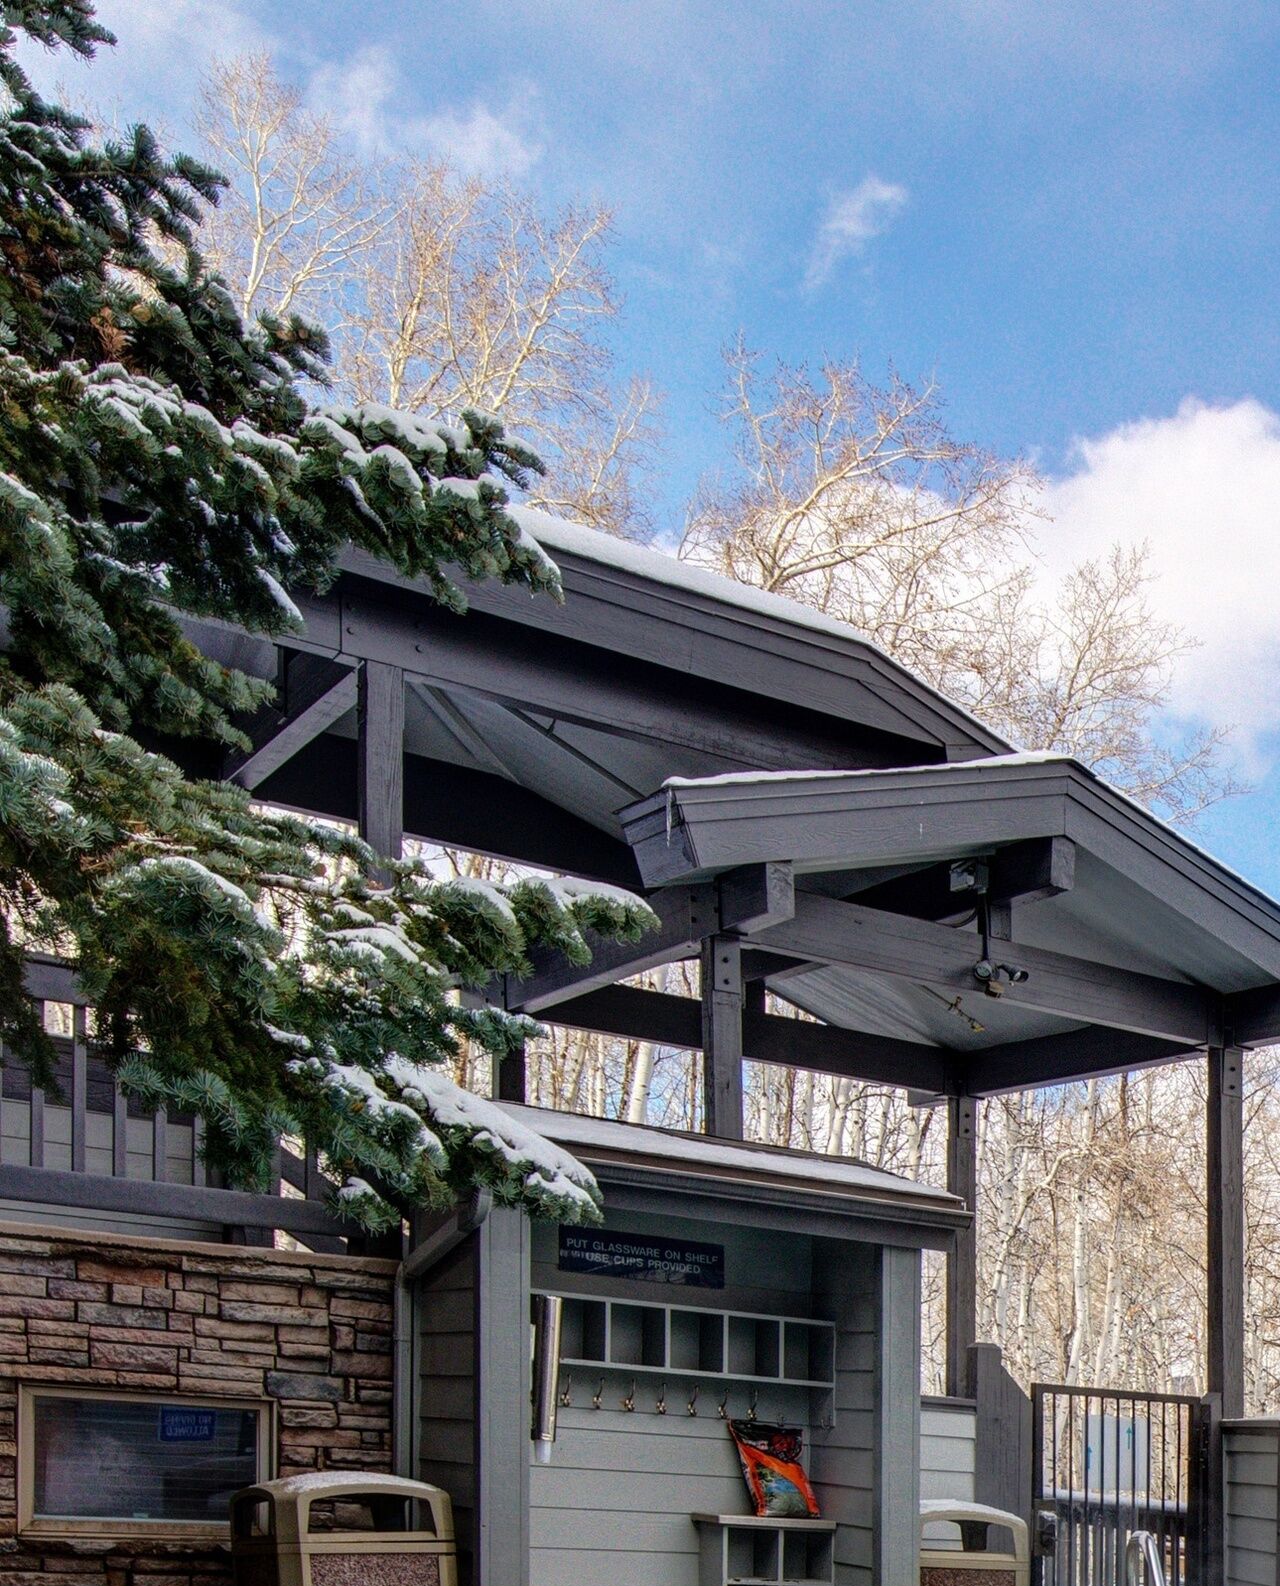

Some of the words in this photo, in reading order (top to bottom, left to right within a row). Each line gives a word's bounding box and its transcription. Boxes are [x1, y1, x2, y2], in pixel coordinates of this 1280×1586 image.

[566, 1238, 588, 1249] PUT
[592, 1241, 660, 1258] GLASSWARE
[664, 1250, 682, 1261] ON
[685, 1252, 718, 1264] SHELF
[586, 1252, 609, 1264] USE
[613, 1255, 644, 1268] CUPS
[648, 1260, 701, 1274] PROVIDED
